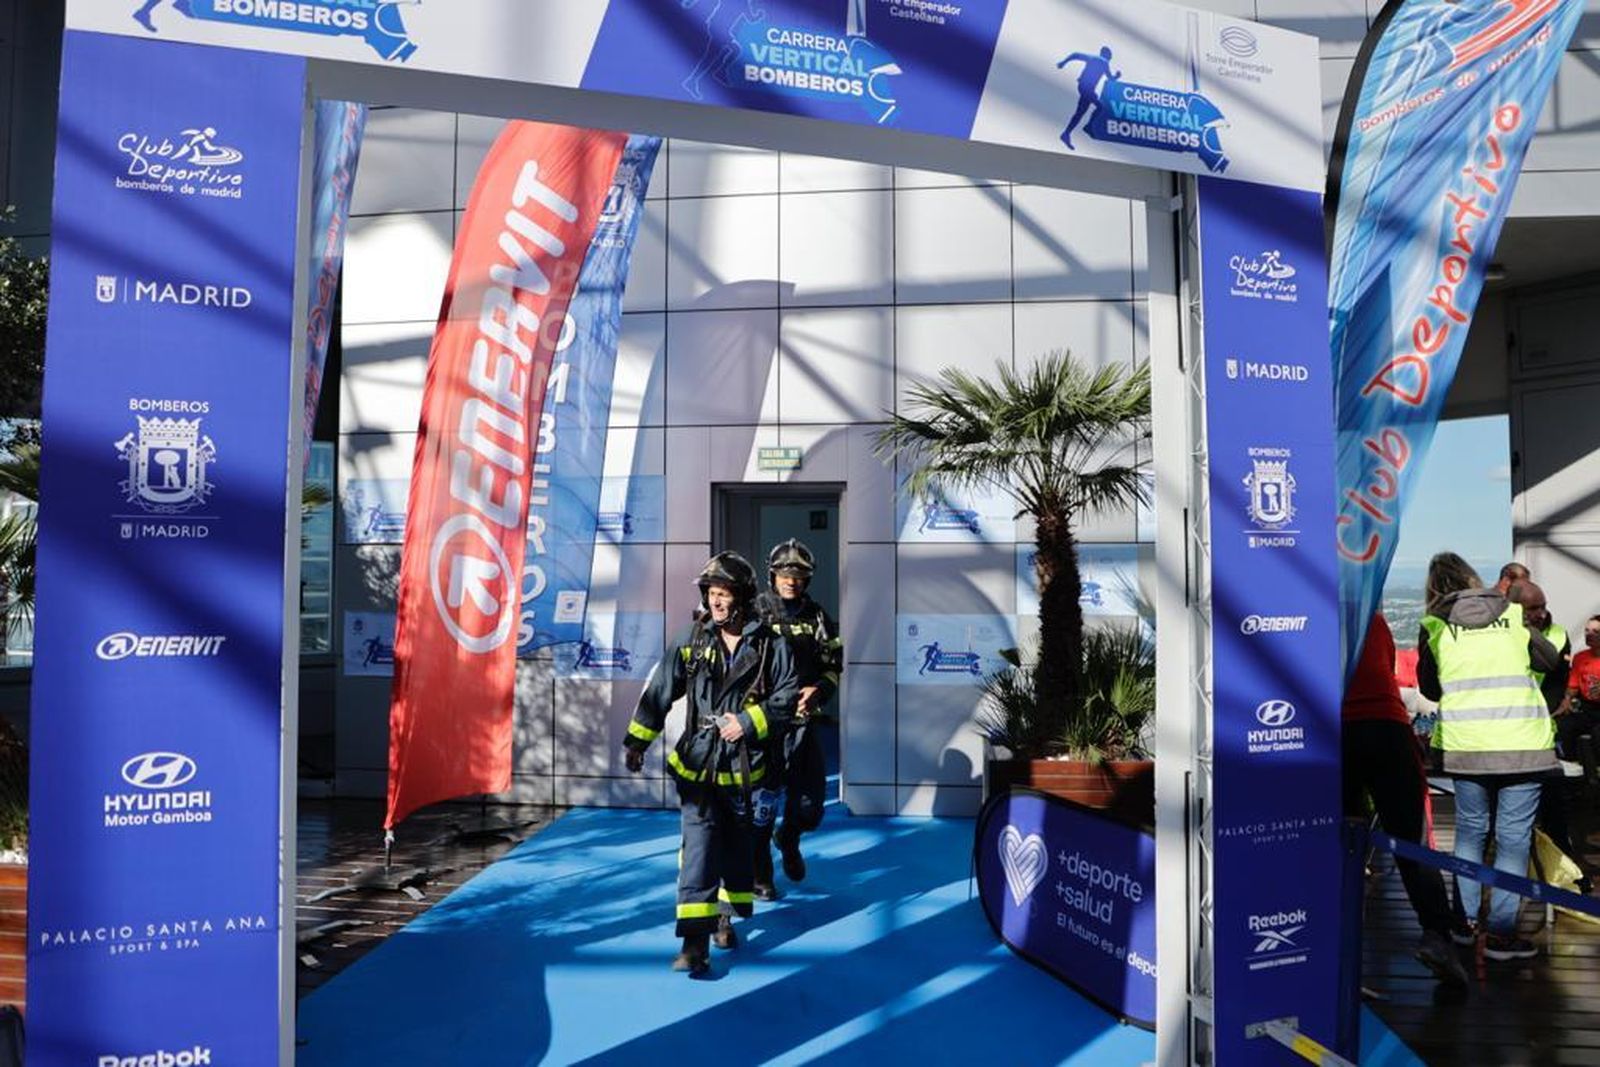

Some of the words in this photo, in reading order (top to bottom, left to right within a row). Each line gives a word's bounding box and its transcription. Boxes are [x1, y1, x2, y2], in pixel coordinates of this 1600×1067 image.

[213, 0, 368, 29] BOMBEROS
[890, 6, 945, 24] Castellana
[903, 0, 961, 15] Emperador
[766, 27, 849, 54] CARRERA
[751, 43, 869, 78] VERTICAL
[1228, 57, 1273, 75] Emperador
[744, 65, 864, 97] BOMBEROS
[1123, 86, 1188, 110] CARRERA
[1357, 86, 1446, 133] bomberos
[1454, 70, 1478, 91] de
[1111, 102, 1204, 131] VERTICAL
[118, 133, 174, 156] Club
[1106, 120, 1200, 148] BOMBEROS
[128, 152, 243, 185] Deportivo
[115, 176, 174, 193] bomberos
[180, 183, 195, 195] de
[201, 187, 242, 199] madrid
[1229, 255, 1260, 273] Club
[1361, 102, 1521, 406] Deportivo
[1237, 269, 1297, 292] Deportivo
[135, 280, 252, 308] MADRID
[450, 159, 579, 529] ENERVIT
[1246, 362, 1309, 381] MADRID
[129, 398, 210, 414] BOMBEROS
[1336, 426, 1411, 562] Club
[142, 525, 209, 538] MADRID
[1260, 537, 1296, 547] MADRID
[1259, 616, 1308, 632] ENERVIT
[135, 635, 226, 657] ENERVIT
[1247, 728, 1304, 743] HYUNDAI
[104, 790, 212, 812] HYUNDAI
[105, 814, 150, 827] Motor
[152, 810, 212, 824] Gamboa
[1218, 823, 1265, 837] PALACIO
[1271, 819, 1306, 832] SANTA
[1312, 816, 1334, 827] ANA
[1057, 850, 1143, 902] +deporte
[1055, 880, 1114, 926] +salud
[41, 925, 133, 947] PALACIO
[147, 919, 213, 937] SANTA
[225, 915, 267, 931] ANA
[1248, 908, 1308, 931] Reebok
[110, 941, 152, 955] SPORT
[160, 941, 168, 951] &
[177, 938, 201, 950] SPA
[1057, 911, 1067, 928] El
[1068, 916, 1100, 946] futuro
[1101, 938, 1114, 954] es
[1115, 945, 1126, 961] el
[98, 1045, 212, 1067] Reebok
